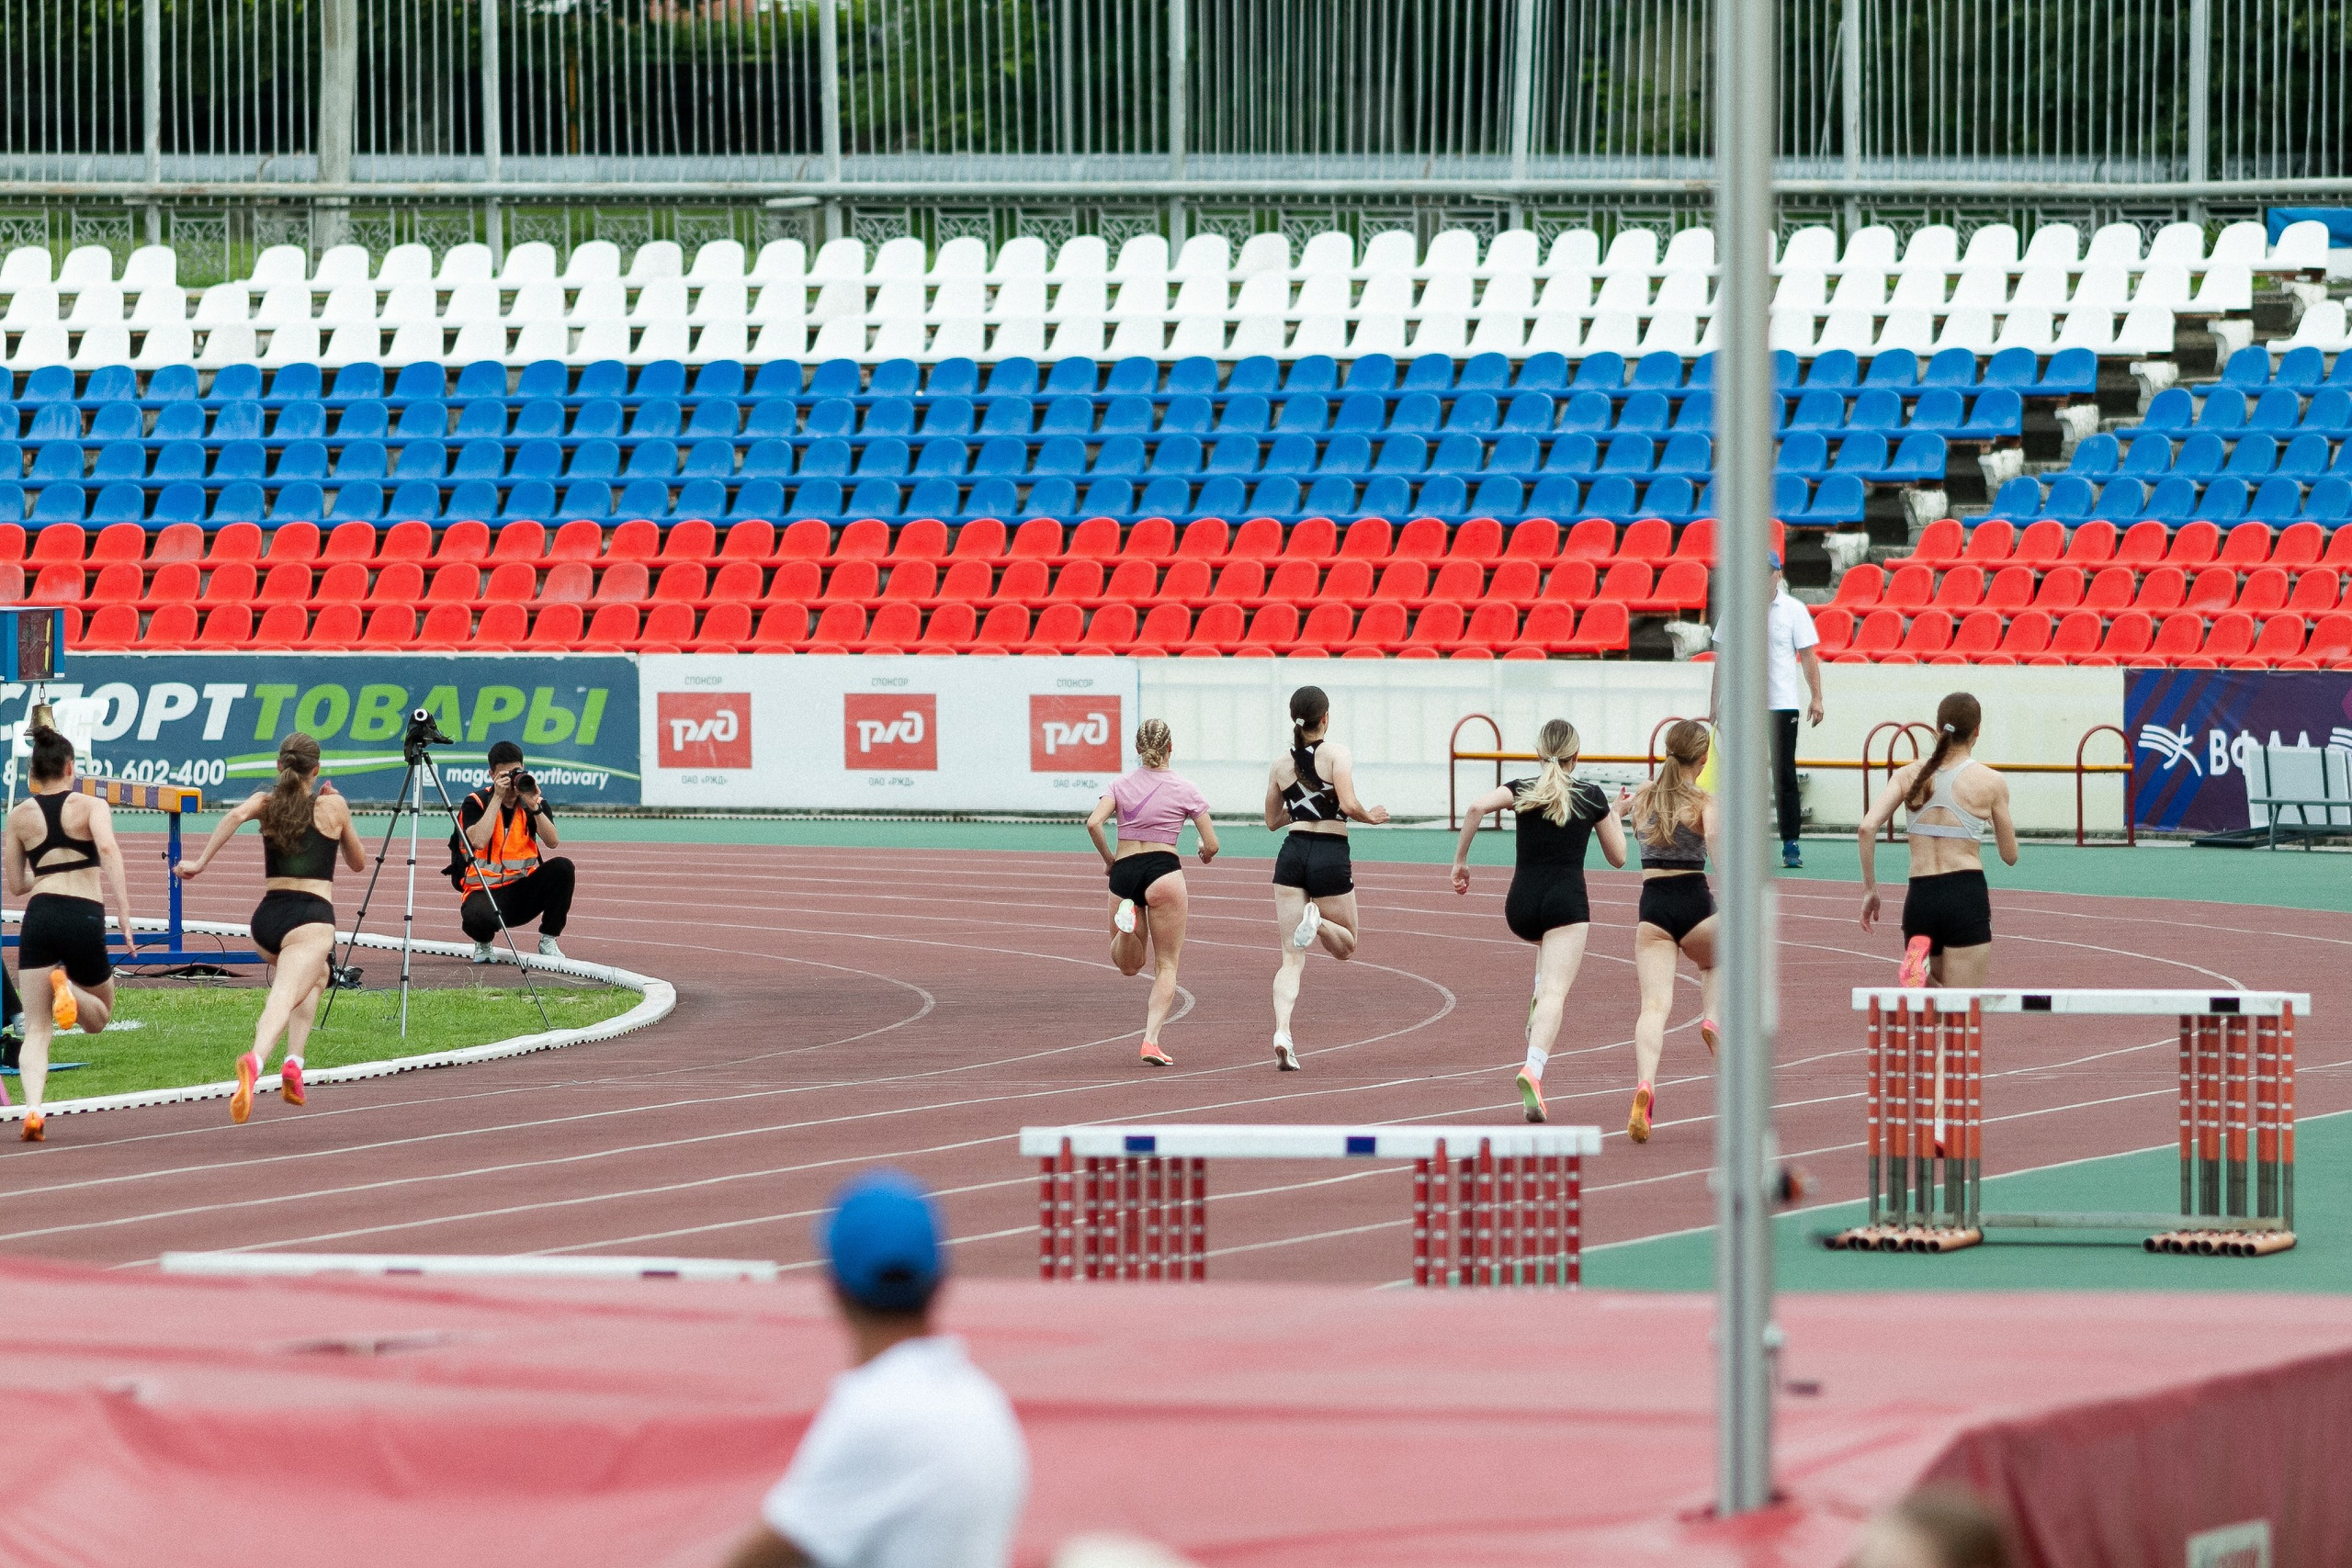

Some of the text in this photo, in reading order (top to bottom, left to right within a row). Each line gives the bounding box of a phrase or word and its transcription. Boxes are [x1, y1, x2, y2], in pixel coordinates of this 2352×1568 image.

[684, 676, 723, 685] СПОНСОР
[871, 678, 909, 686] СПОНСОР
[1057, 679, 1094, 688] СПОНСОР
